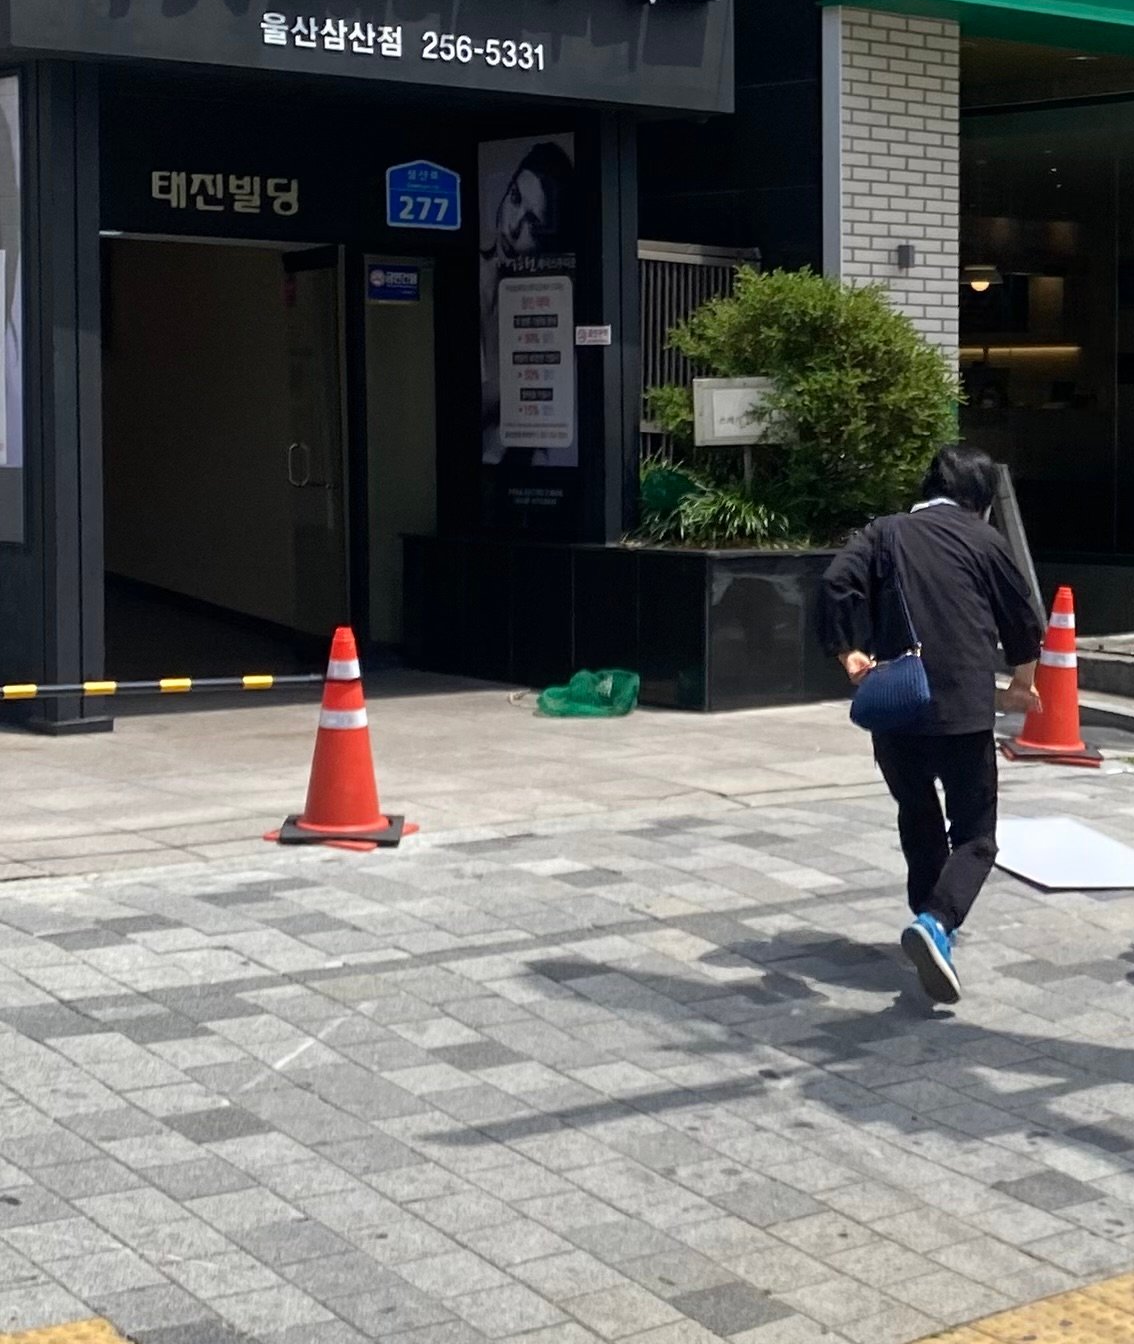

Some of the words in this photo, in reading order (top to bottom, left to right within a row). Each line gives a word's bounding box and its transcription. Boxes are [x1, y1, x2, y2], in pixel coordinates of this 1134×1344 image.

[260, 11, 404, 58] 울산삼산점
[421, 30, 546, 71] 256-5331
[151, 169, 301, 216] 태진빌딩
[399, 195, 450, 222] 277
